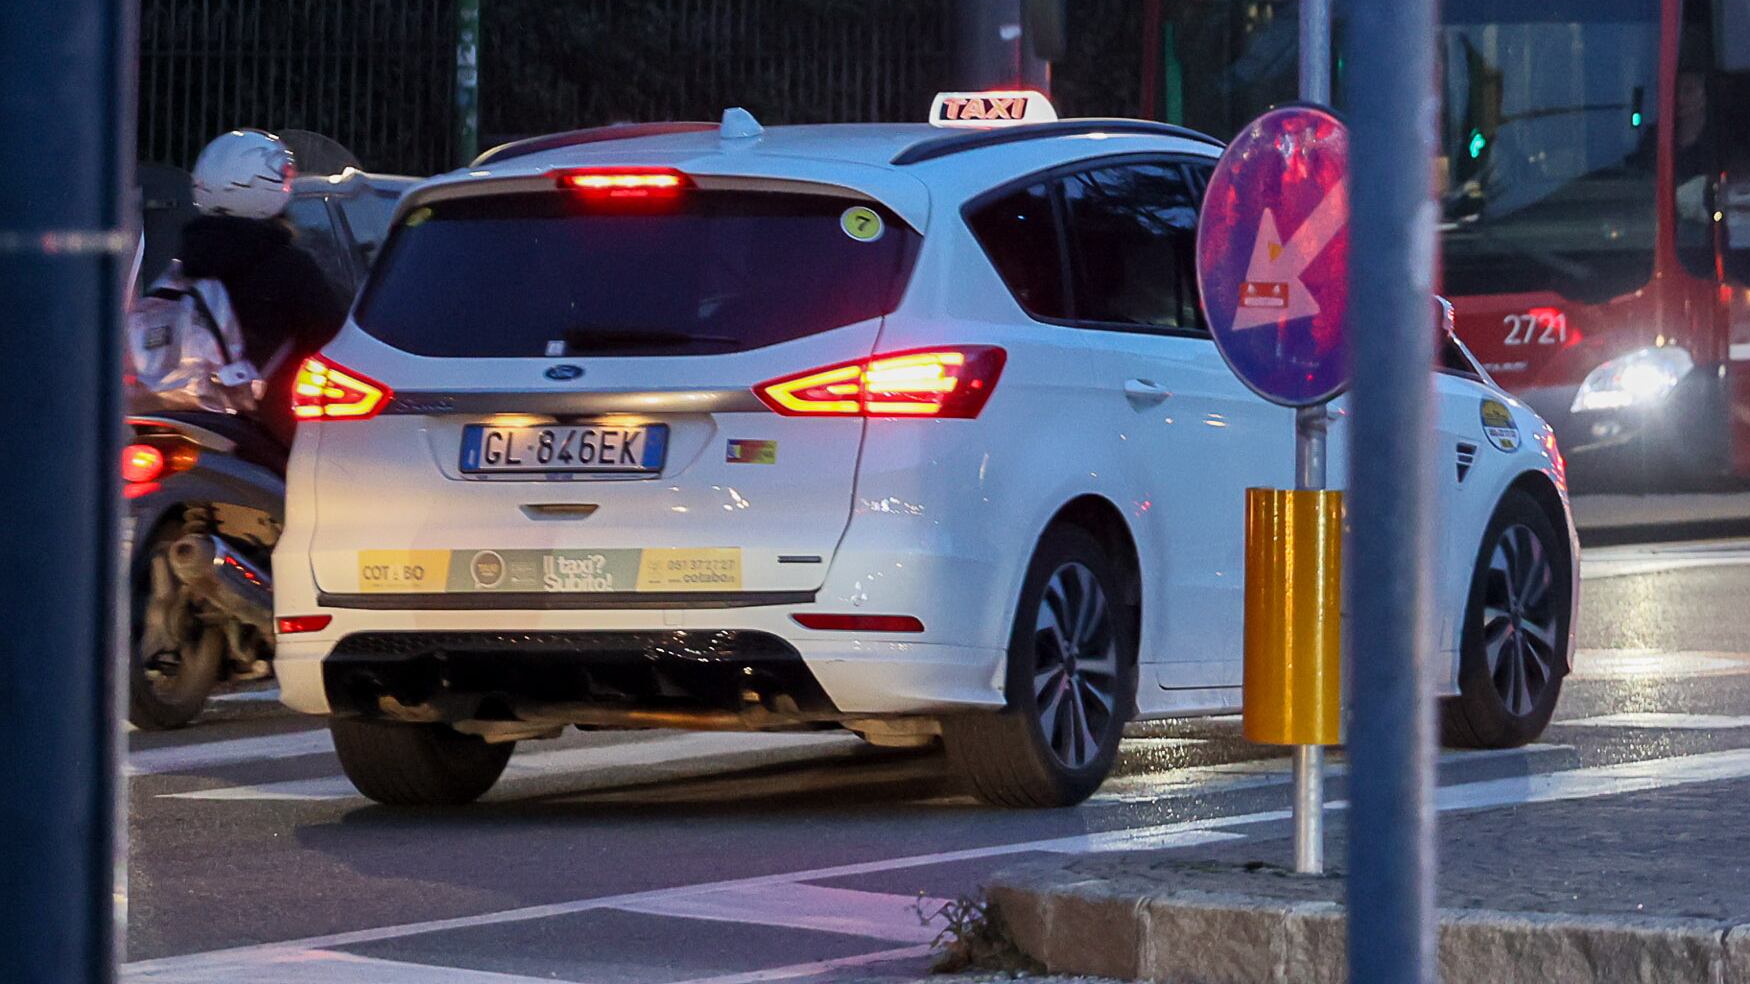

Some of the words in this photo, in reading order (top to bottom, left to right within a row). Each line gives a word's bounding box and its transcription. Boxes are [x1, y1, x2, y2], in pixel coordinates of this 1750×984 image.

[943, 97, 1028, 120] TAXI
[855, 215, 871, 232] 7
[1503, 312, 1567, 345] 2721
